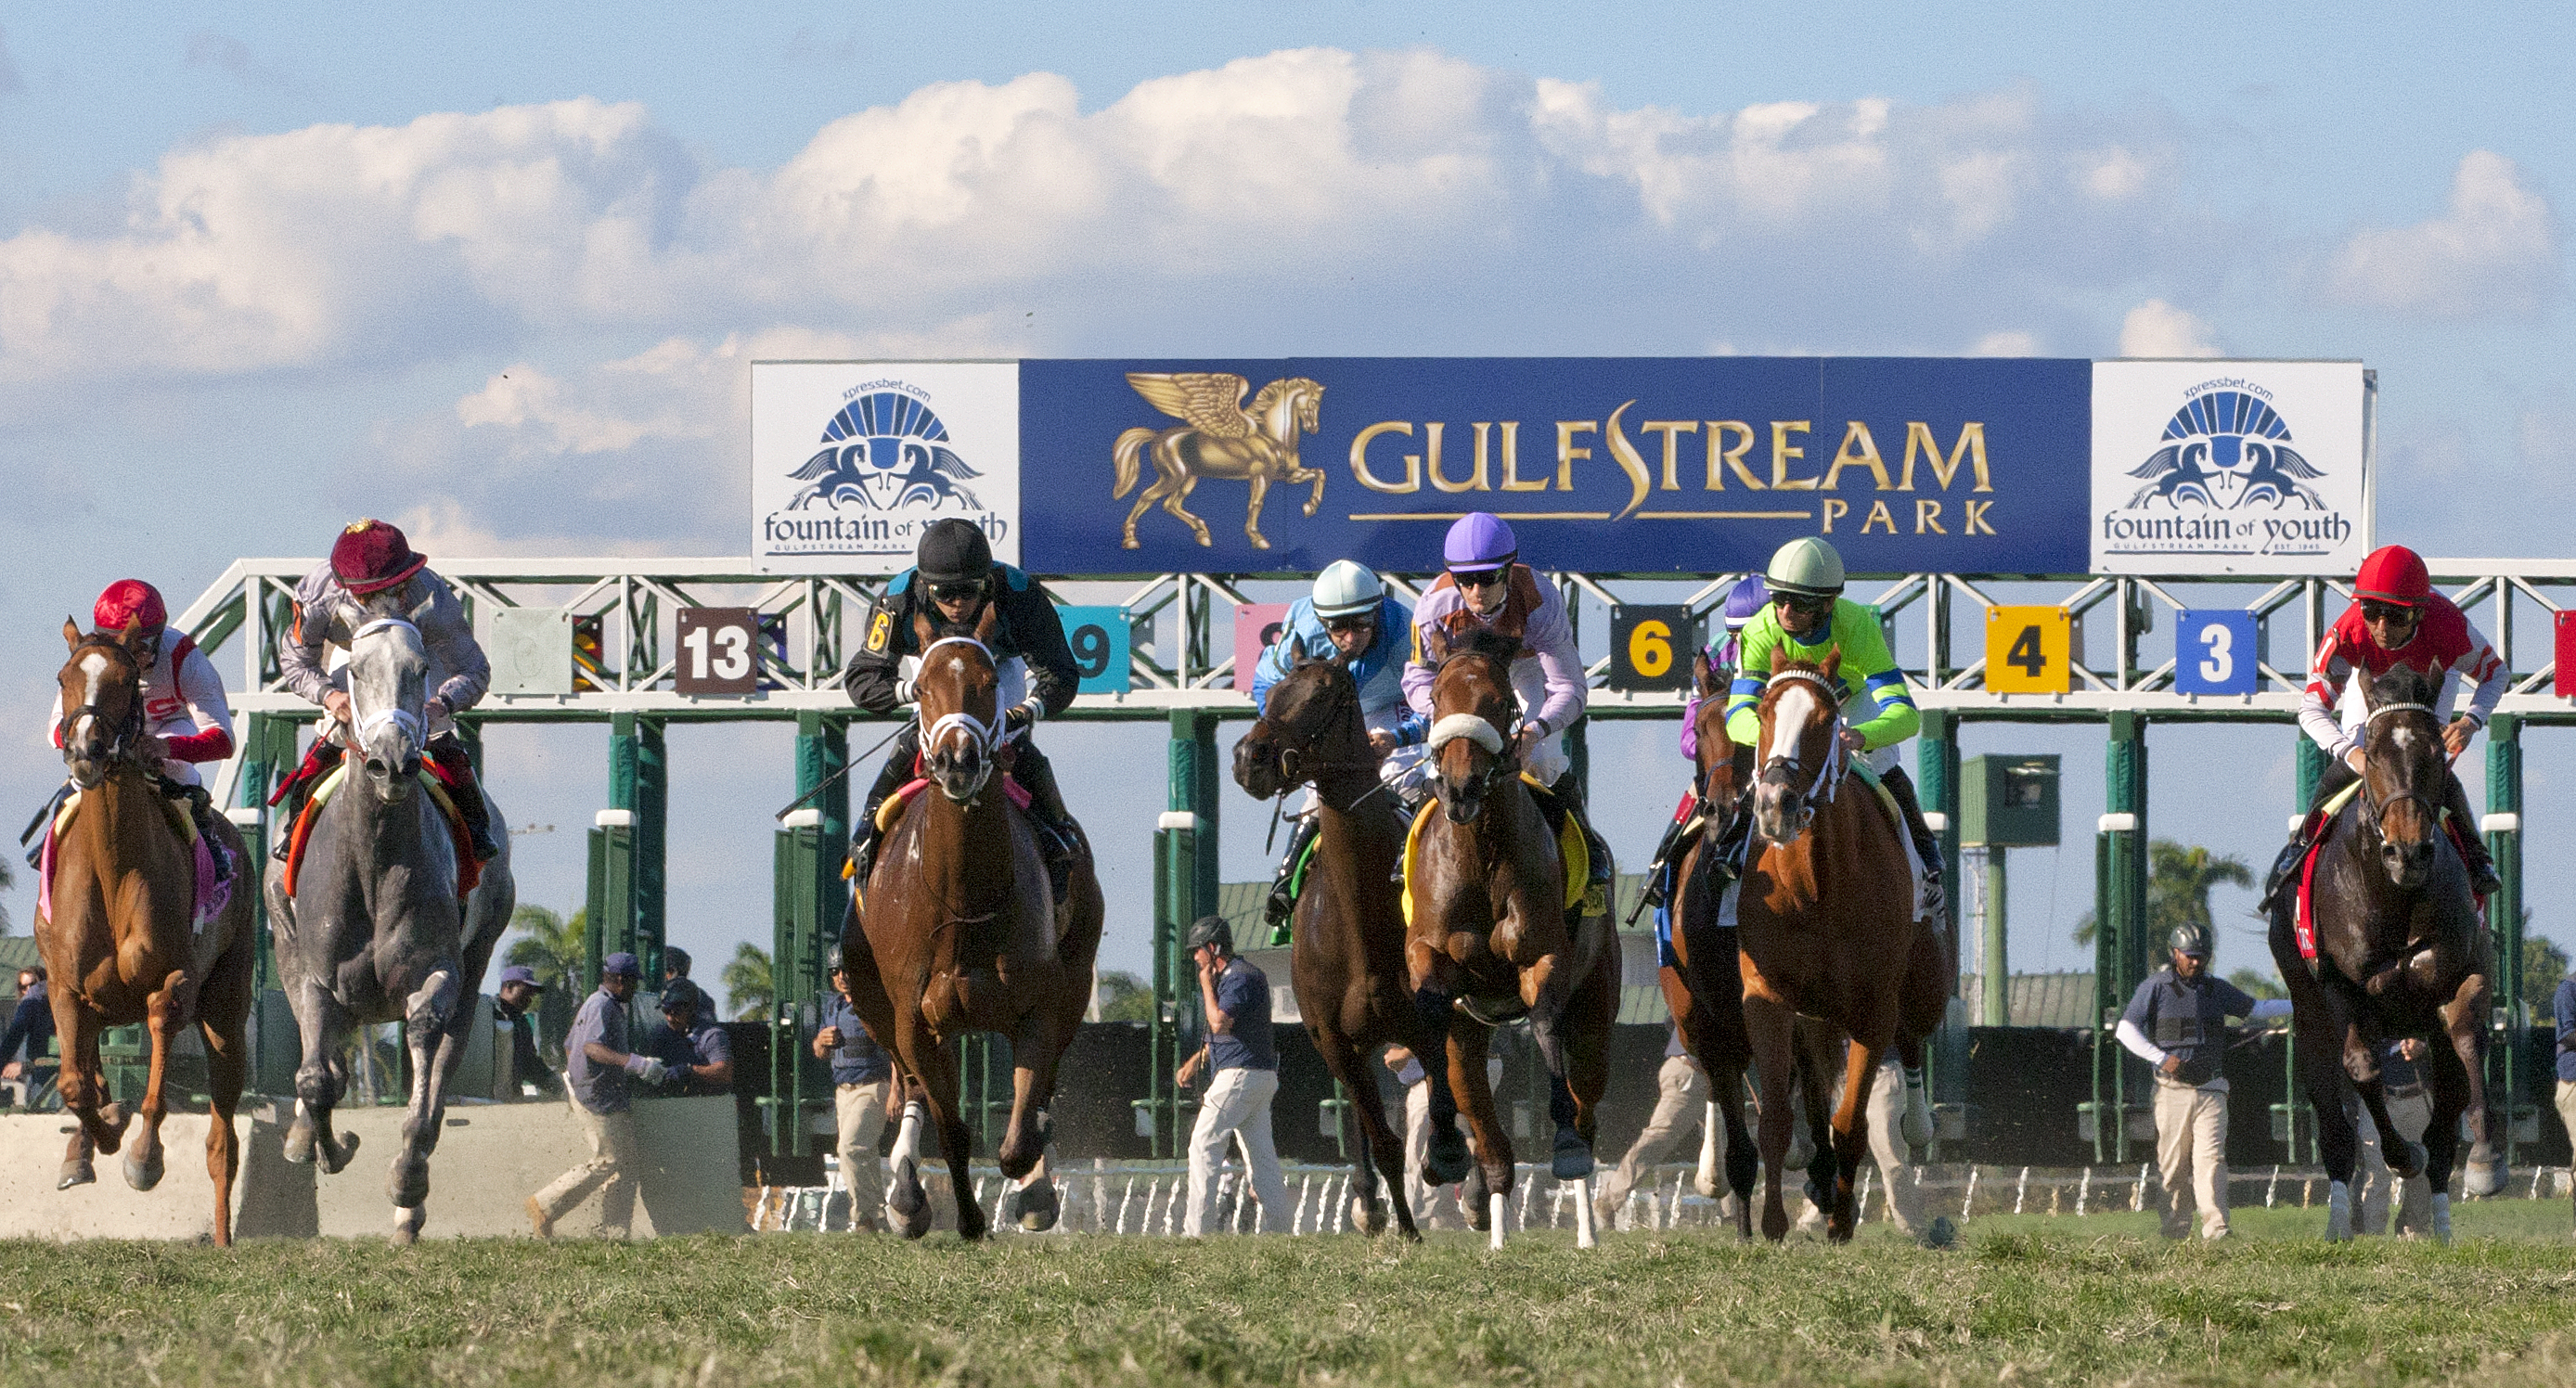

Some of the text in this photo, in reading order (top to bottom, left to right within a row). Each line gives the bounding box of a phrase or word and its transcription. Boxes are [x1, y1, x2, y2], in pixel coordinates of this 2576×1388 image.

[843, 378, 932, 401] xpressbet.com
[2183, 377, 2273, 401] xpressbet.com
[1348, 398, 1994, 521] GULFSTREAM
[764, 511, 891, 541] fountain
[894, 520, 914, 536] of
[1822, 498, 1996, 535] PARK
[2103, 509, 2351, 555] fountain of youth
[774, 543, 864, 551] GULFSTREAM
[683, 624, 751, 680] 13
[867, 612, 889, 650] 6
[1071, 623, 1111, 678] 9
[1629, 619, 1673, 677] 6
[2006, 624, 2047, 677] 4
[2199, 623, 2233, 682] 3
